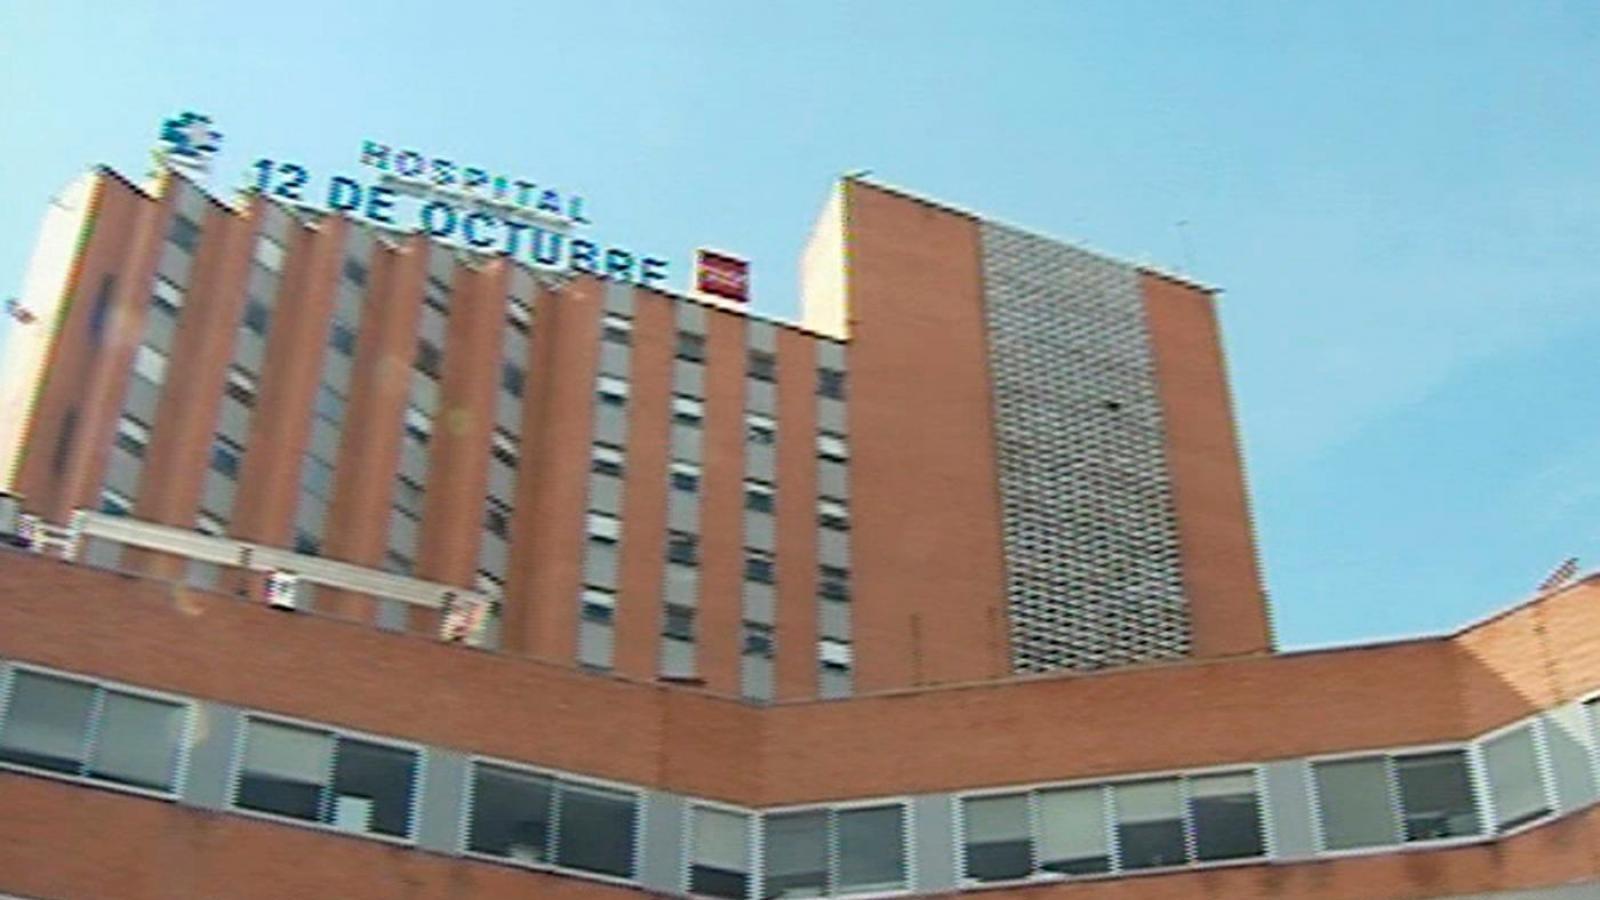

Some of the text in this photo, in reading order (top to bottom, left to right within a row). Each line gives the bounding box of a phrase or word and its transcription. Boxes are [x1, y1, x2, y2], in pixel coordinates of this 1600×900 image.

[253, 159, 309, 201] 12
[328, 176, 397, 223] DE
[418, 201, 670, 285] OCTUBRE
[361, 140, 591, 224] HOSPITAL
